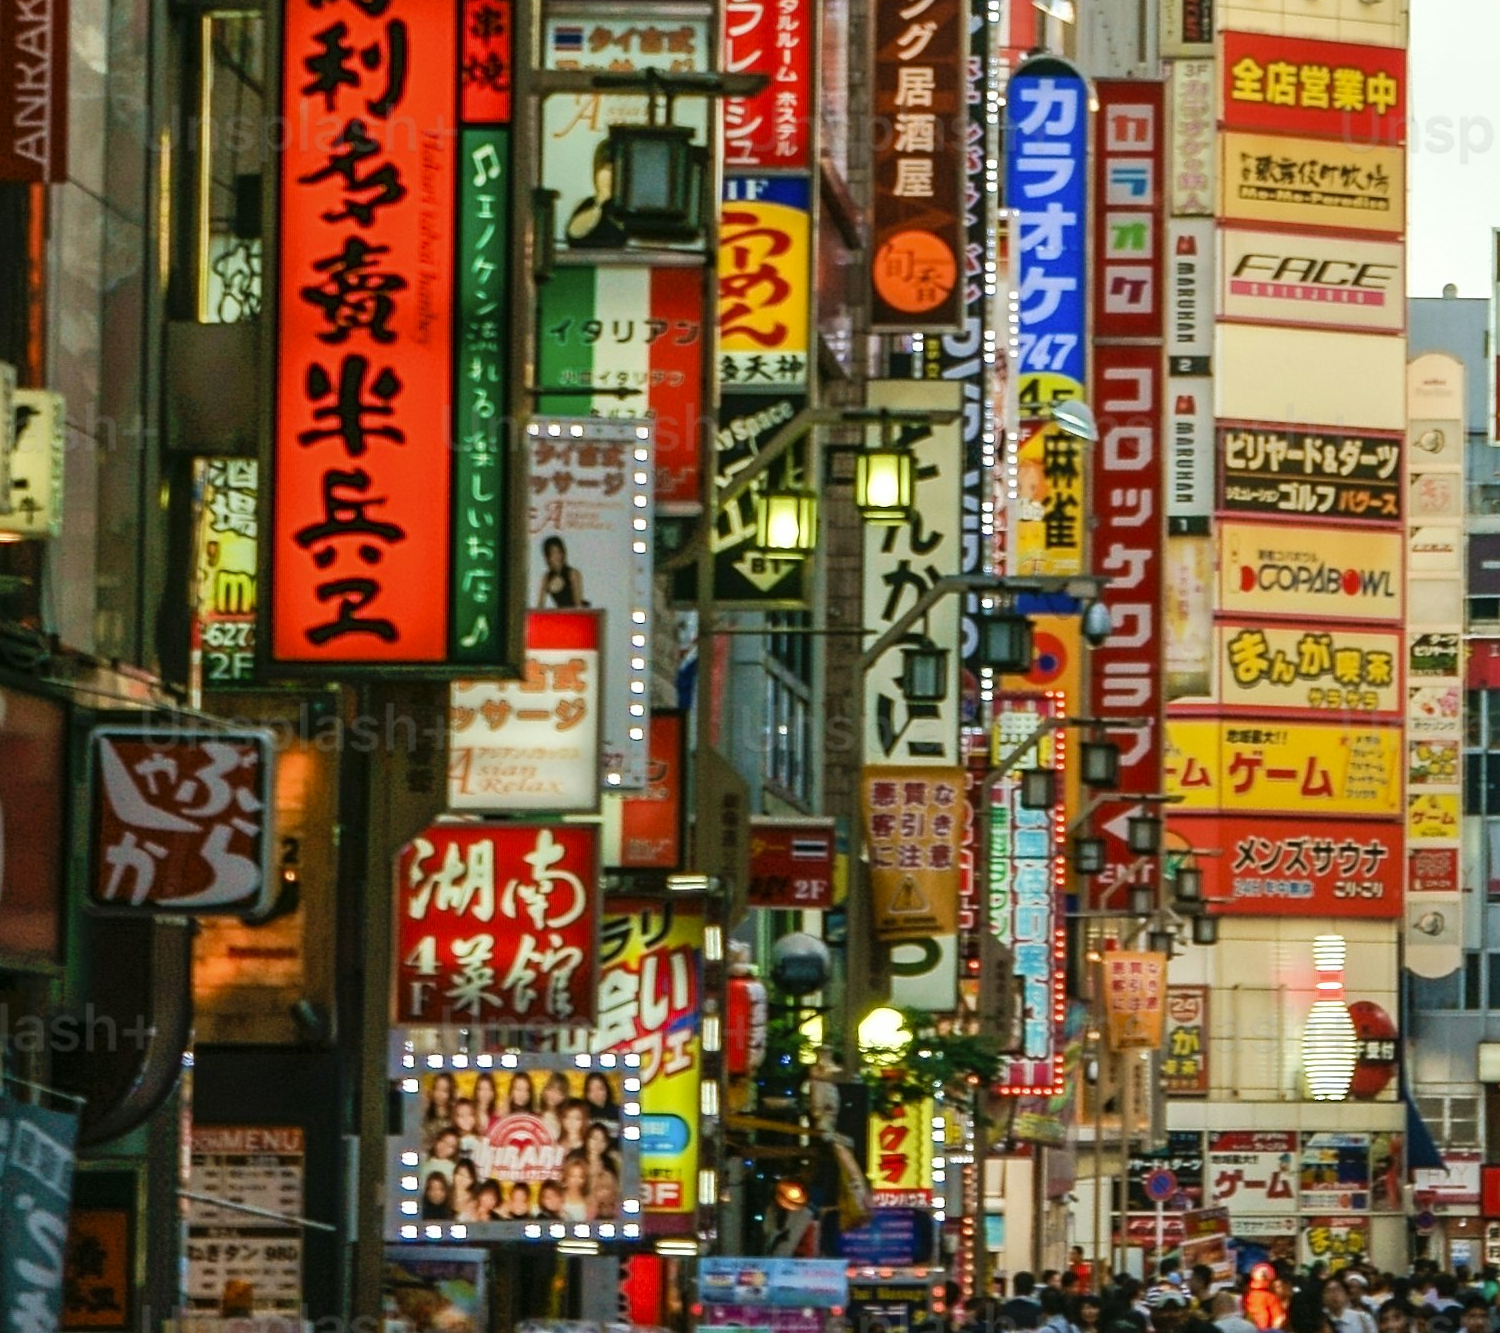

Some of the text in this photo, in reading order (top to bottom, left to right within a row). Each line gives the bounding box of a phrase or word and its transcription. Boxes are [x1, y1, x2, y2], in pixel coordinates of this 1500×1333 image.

[1231, 57, 1398, 115] 全店営業中
[1016, 79, 1079, 326] カラオケ
[1105, 104, 1153, 314] カラオケ
[1232, 253, 1399, 290] FACE
[1018, 334, 1078, 371] 747
[1225, 433, 1399, 480] ビリヤード&ダーツ
[1043, 431, 1077, 551] 麻雀
[1278, 483, 1336, 514] ゴルフ
[1227, 629, 1394, 687] まんが喫茶
[869, 780, 956, 808] 悪質な
[1227, 751, 1335, 799] ゲーム
[870, 812, 955, 840] 客引き
[871, 841, 955, 872] に注意
[1233, 835, 1389, 878] メンズサウナ
[408, 829, 586, 932] 湖南
[793, 878, 827, 901] 2F
[445, 933, 584, 1020] 菜館
[1214, 1170, 1294, 1200] ゲーム
